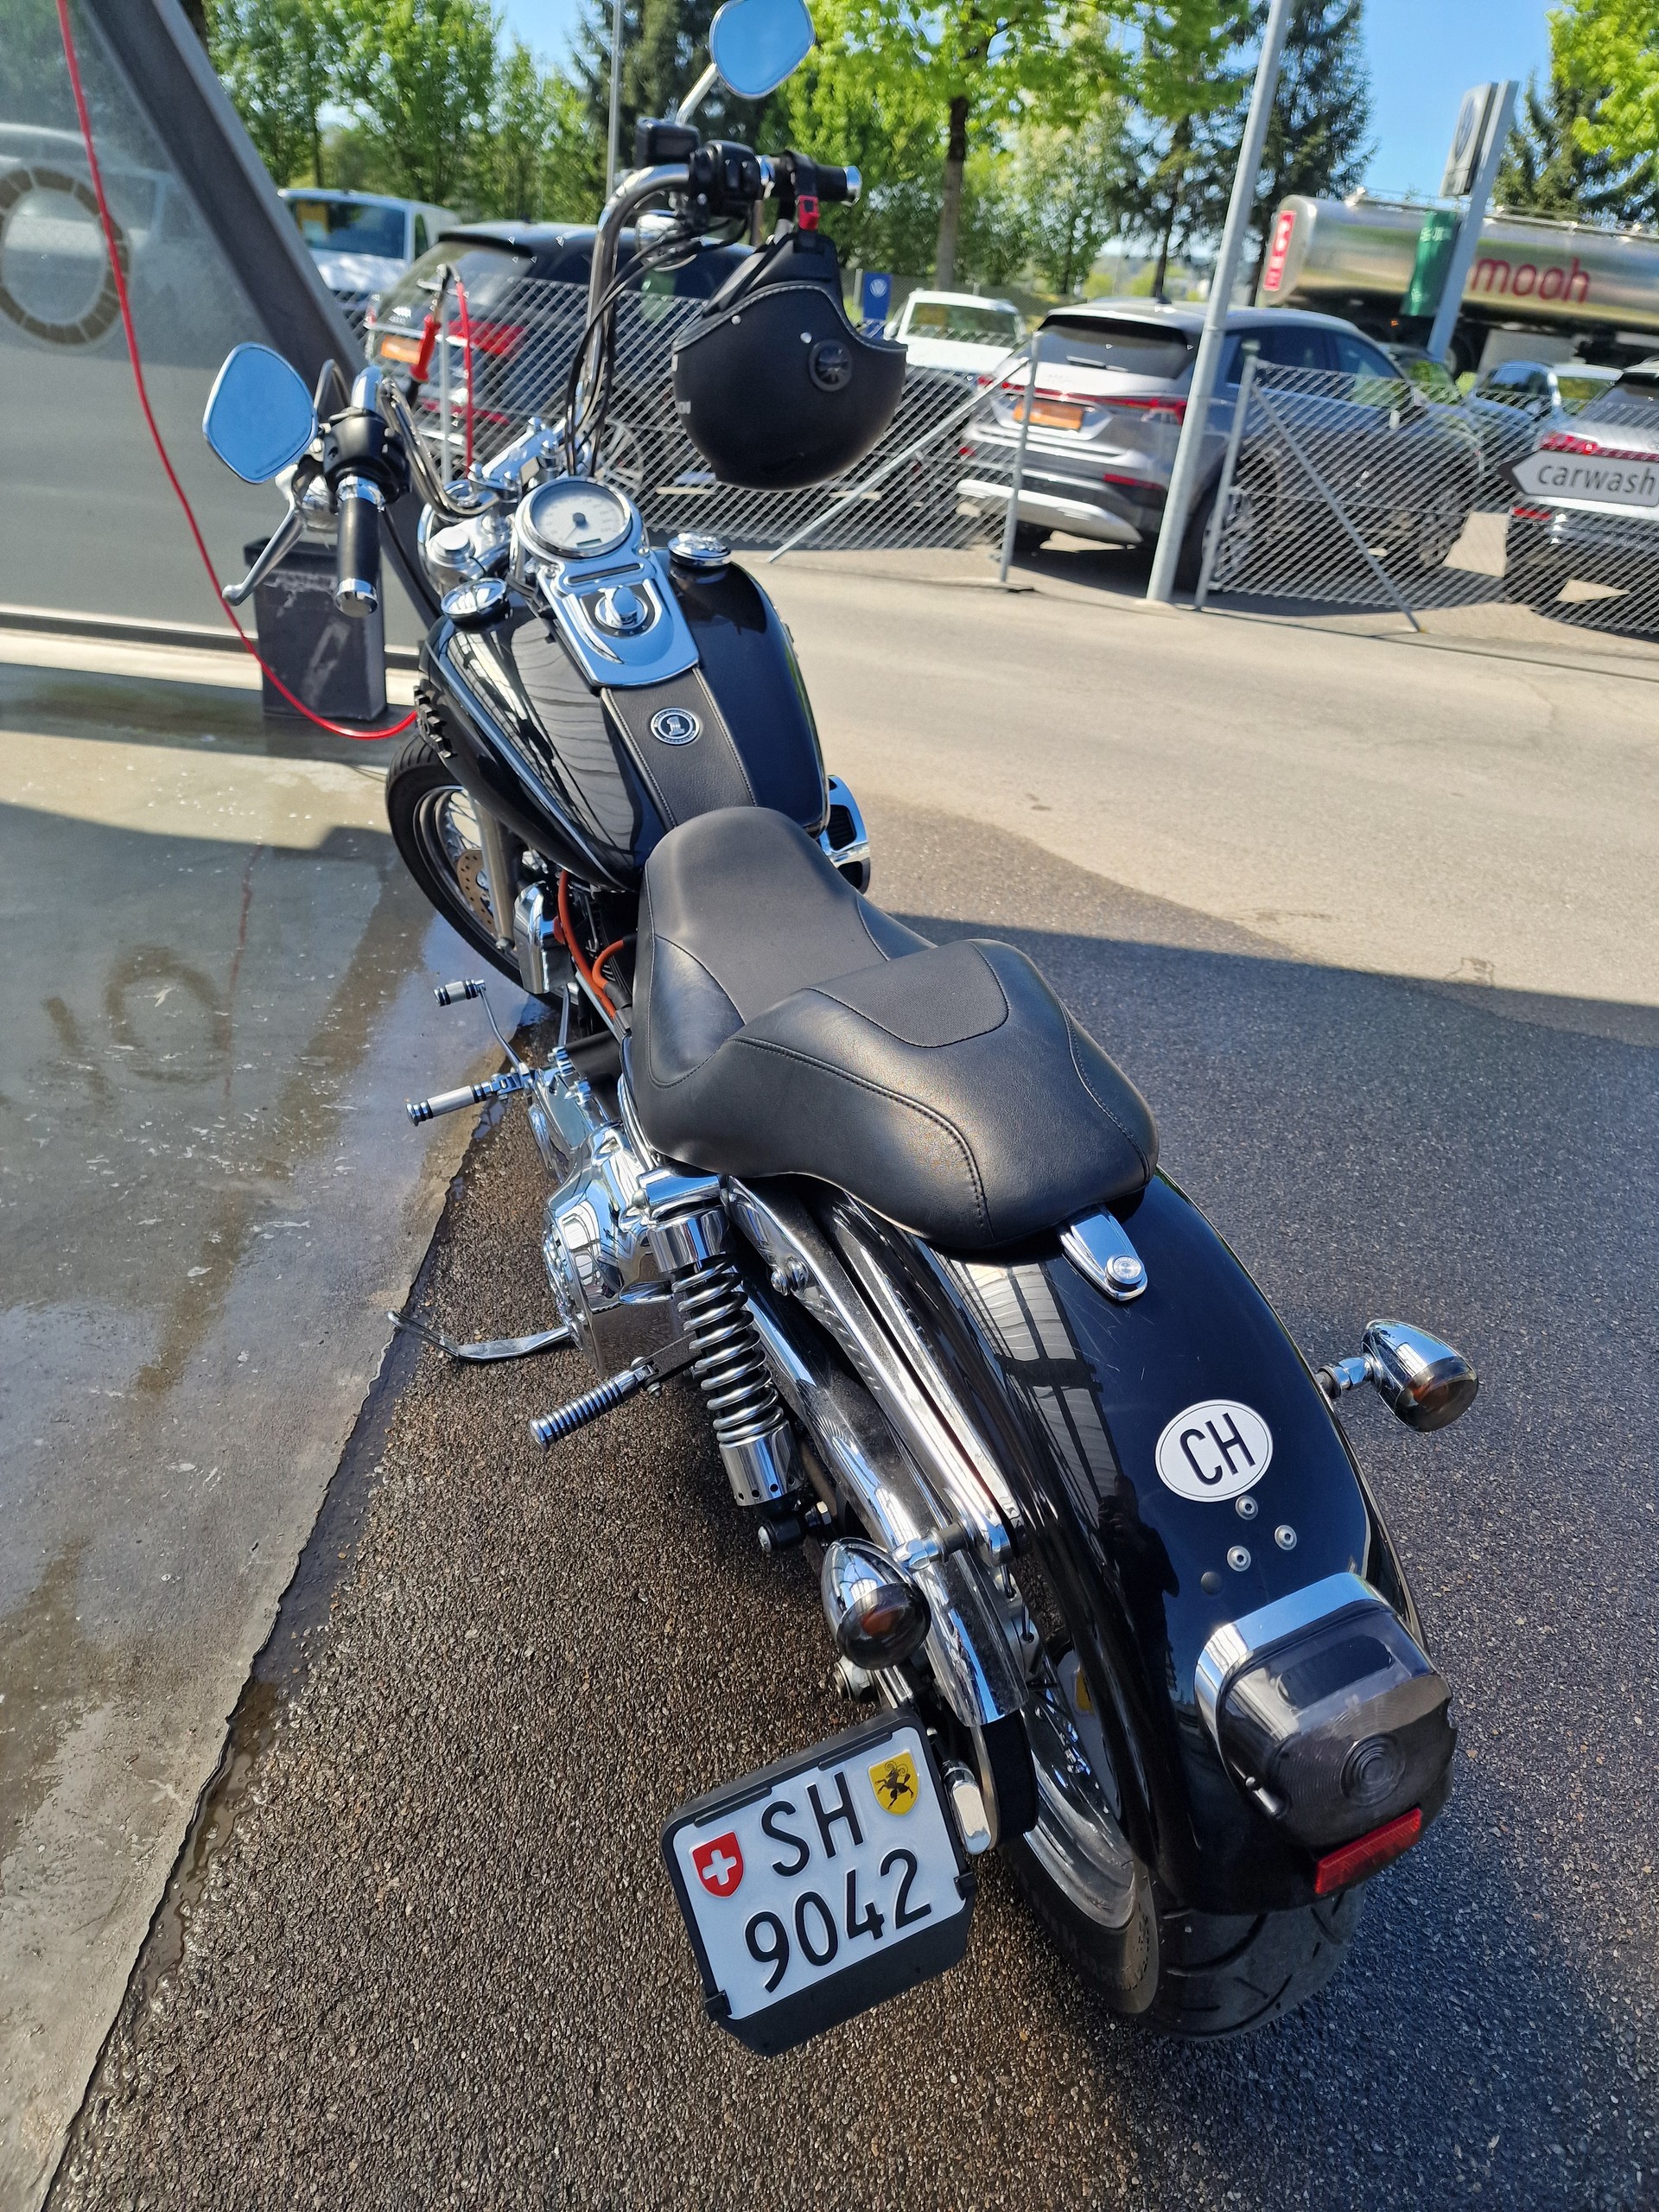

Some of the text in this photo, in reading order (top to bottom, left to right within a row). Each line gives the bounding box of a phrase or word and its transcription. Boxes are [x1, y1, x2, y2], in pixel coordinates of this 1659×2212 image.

[1471, 256, 1590, 304] mooh
[1538, 464, 1656, 495] carwash
[1179, 1412, 1256, 1486] CH
[760, 1771, 863, 1877] SH
[744, 1848, 932, 1993] 9042
